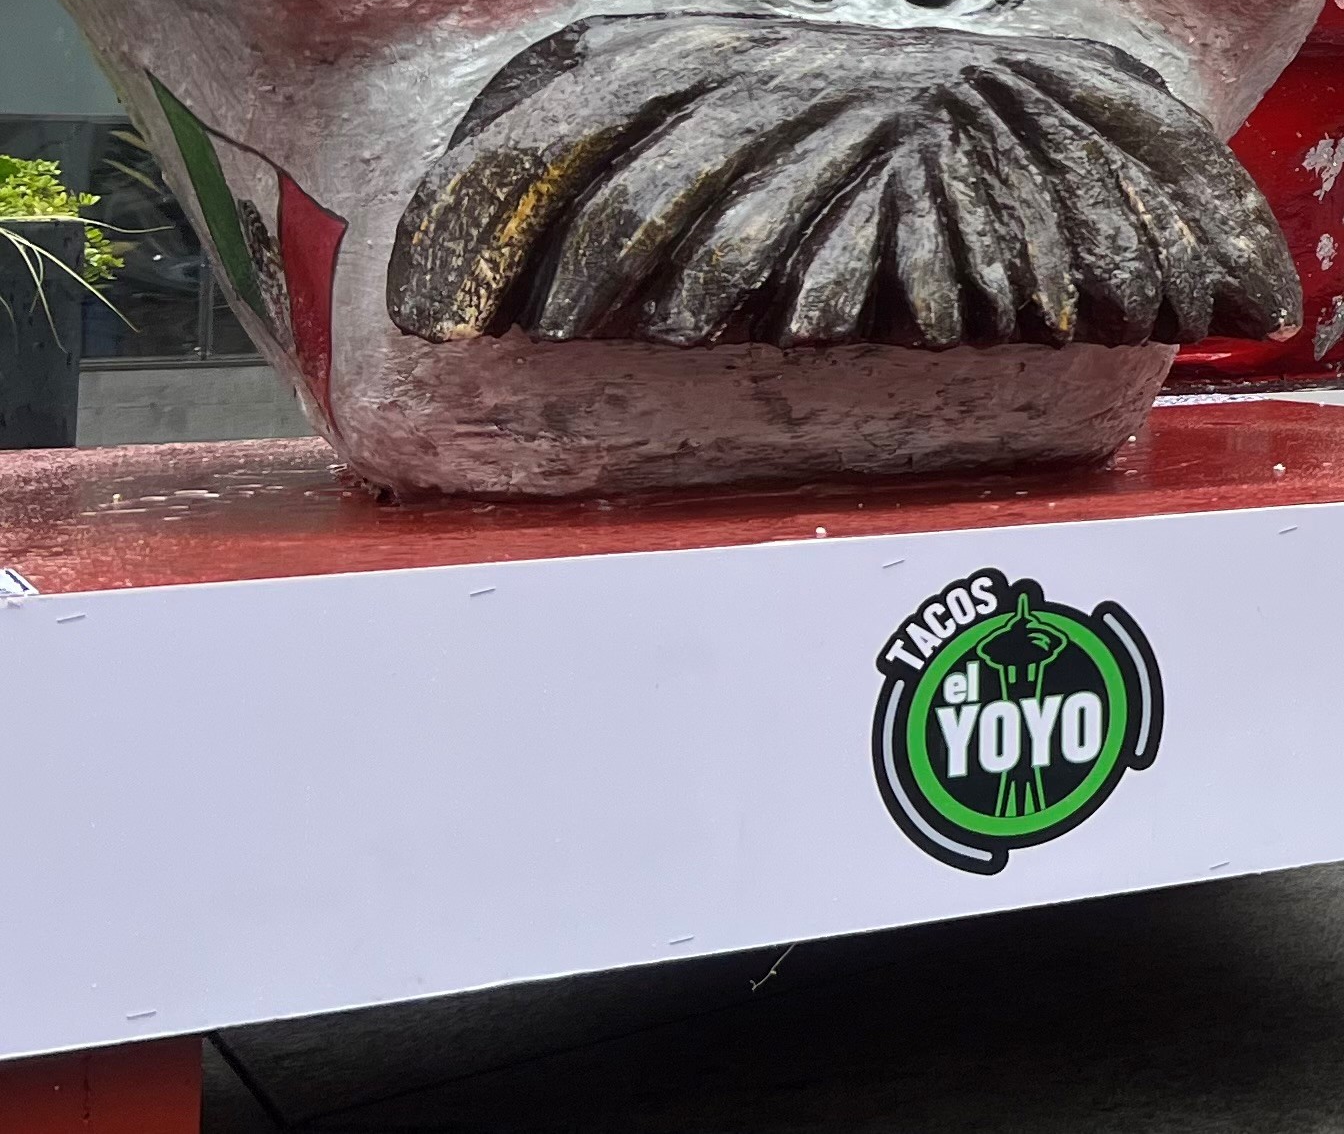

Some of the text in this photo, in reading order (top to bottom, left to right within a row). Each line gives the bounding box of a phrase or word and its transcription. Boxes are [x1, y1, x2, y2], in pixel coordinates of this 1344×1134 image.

[885, 576, 998, 671] TACOS
[942, 661, 980, 704] el
[934, 691, 1103, 779] YOYO
